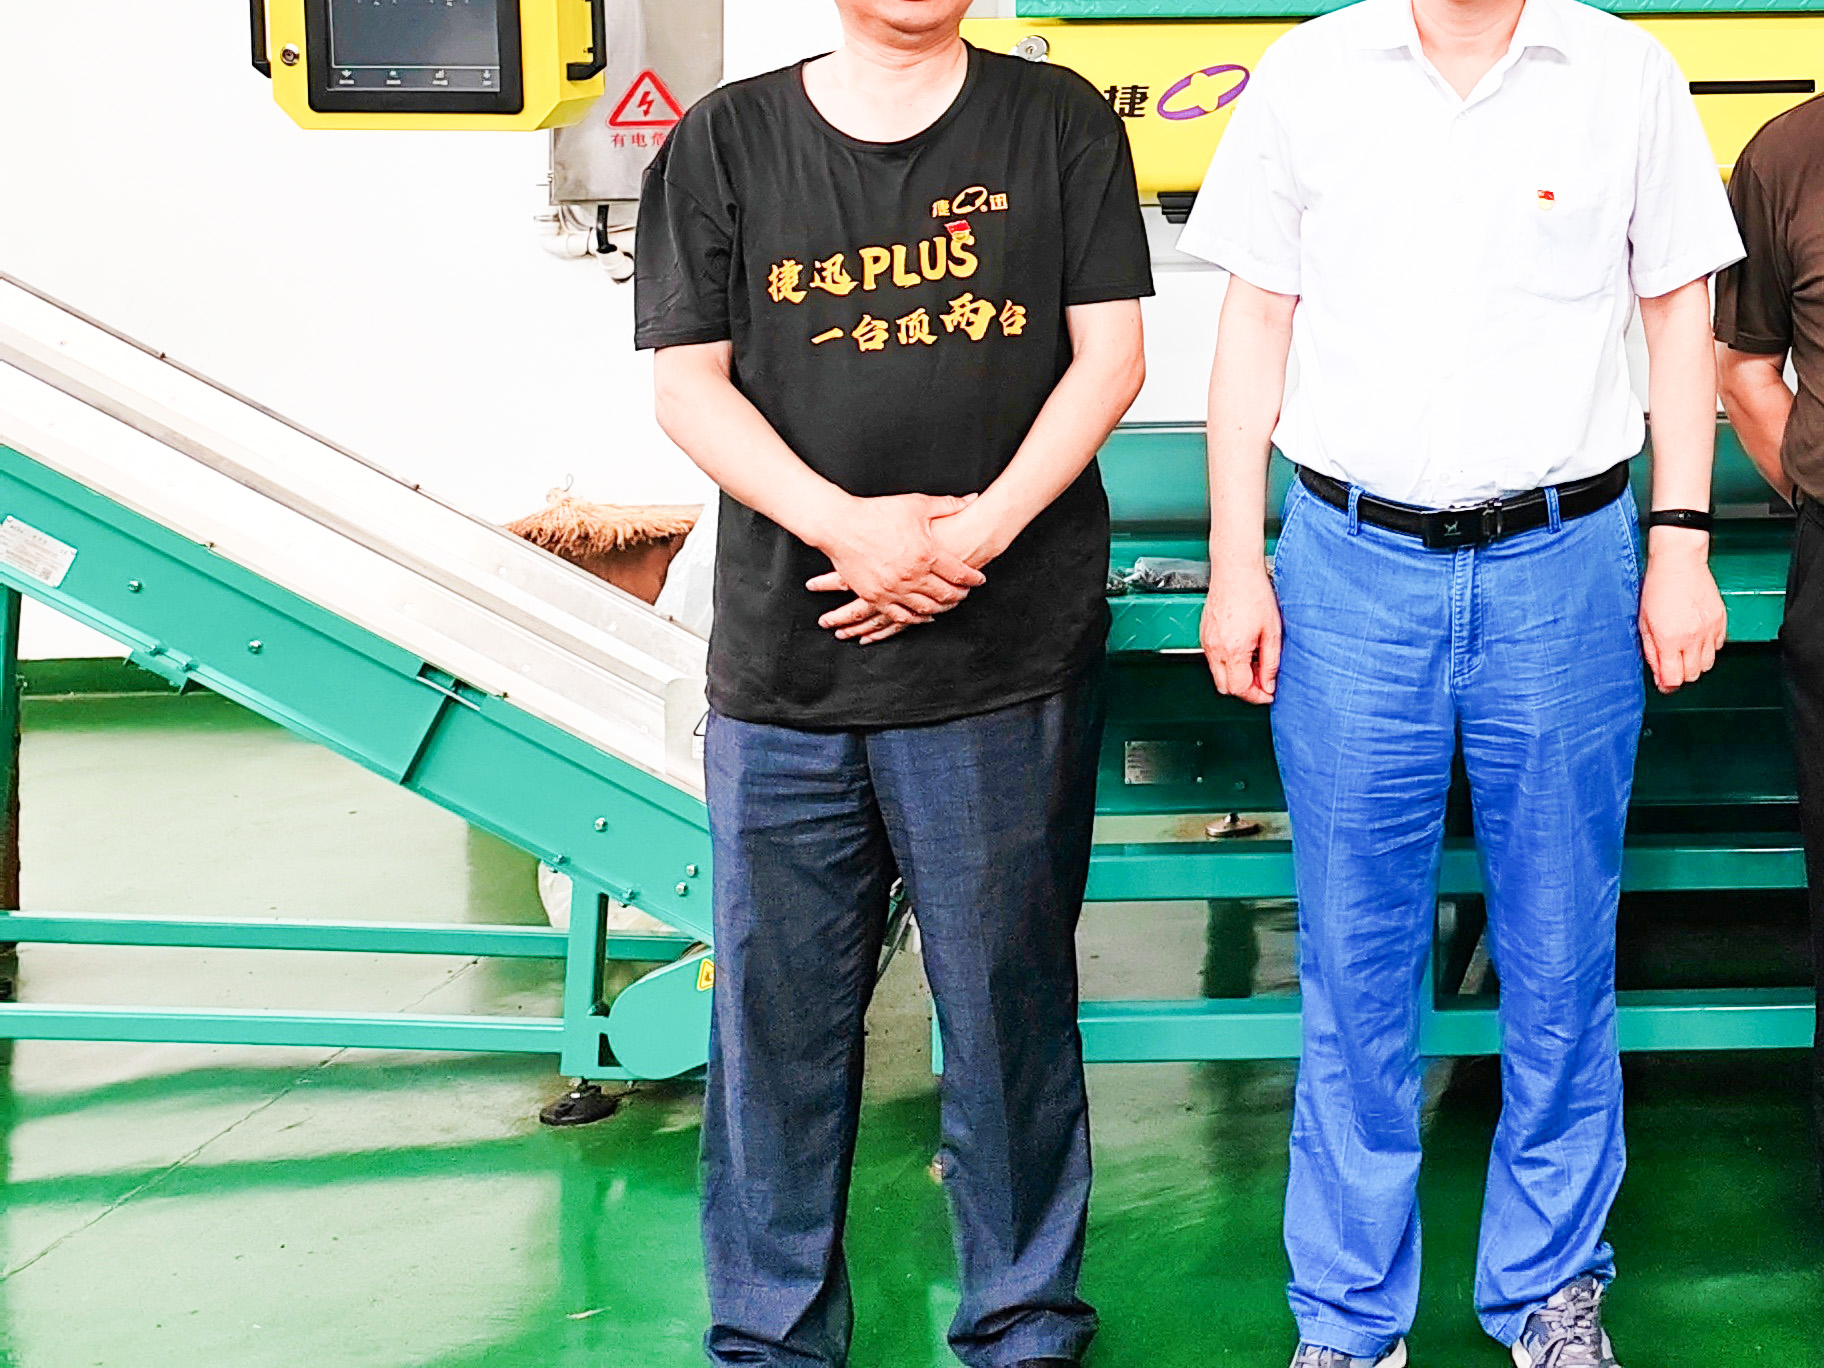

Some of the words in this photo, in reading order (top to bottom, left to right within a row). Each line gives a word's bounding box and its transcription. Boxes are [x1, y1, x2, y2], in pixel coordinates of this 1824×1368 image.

[810, 292, 1028, 353] 一台顶两台
